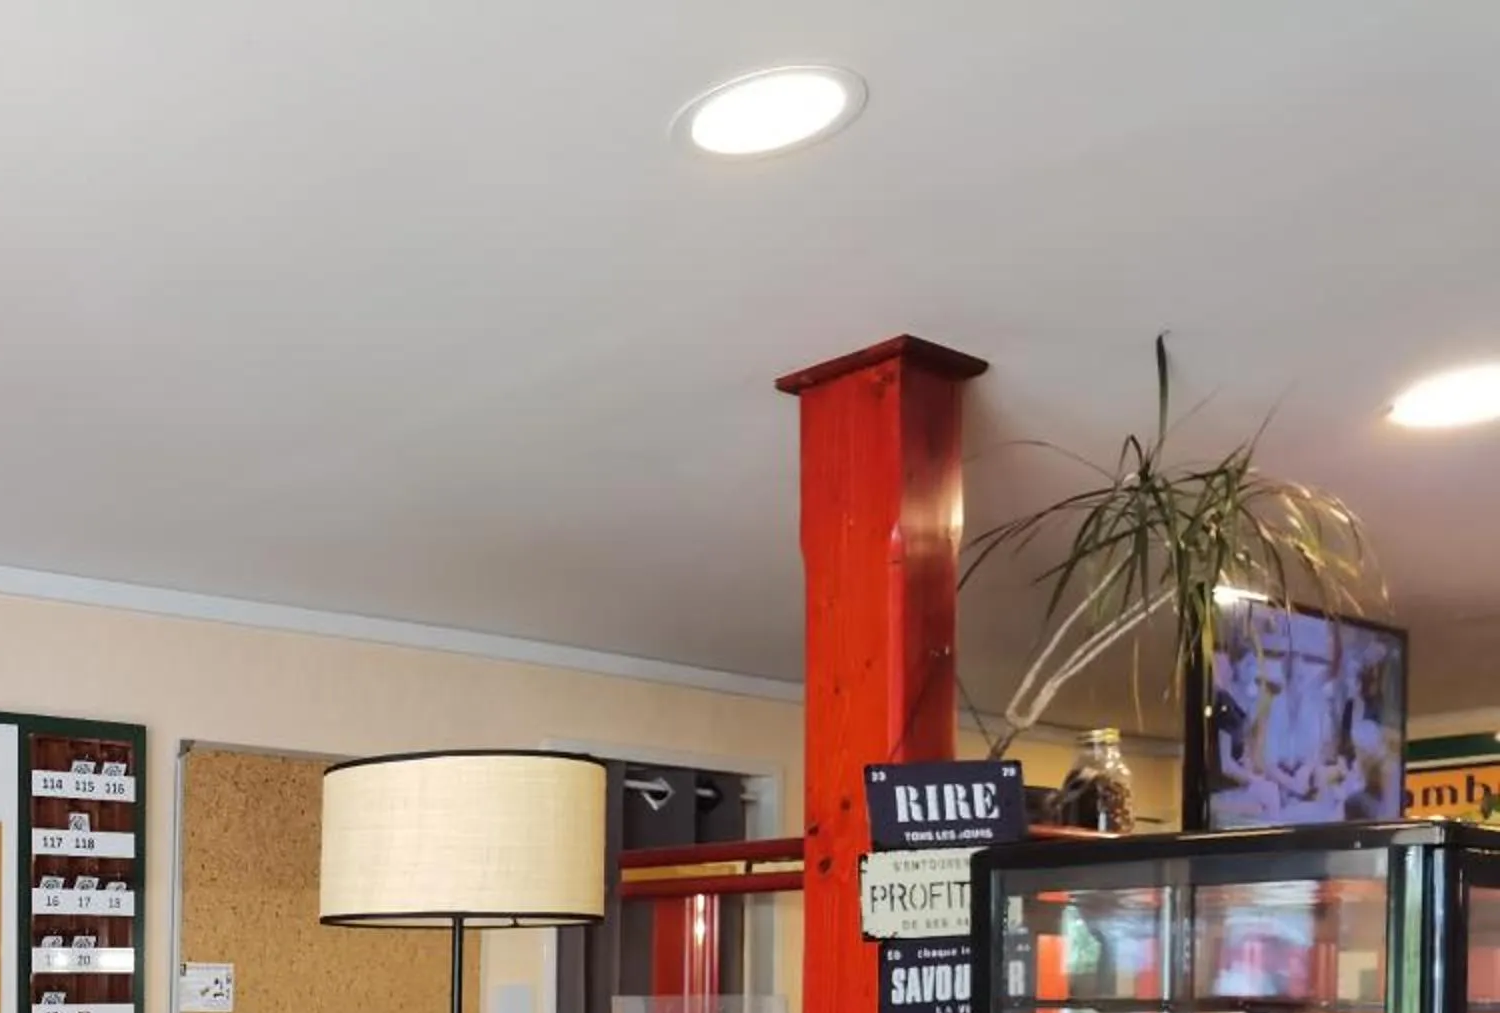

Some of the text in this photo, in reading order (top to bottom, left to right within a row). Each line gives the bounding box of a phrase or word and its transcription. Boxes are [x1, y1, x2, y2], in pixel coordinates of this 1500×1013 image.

[42, 778, 125, 795] 114 115 116
[894, 782, 1000, 823] RIRE
[42, 836, 96, 850] 117 118
[935, 830, 956, 841] LES
[78, 896, 91, 908] 17
[869, 881, 971, 914] PROFIT
